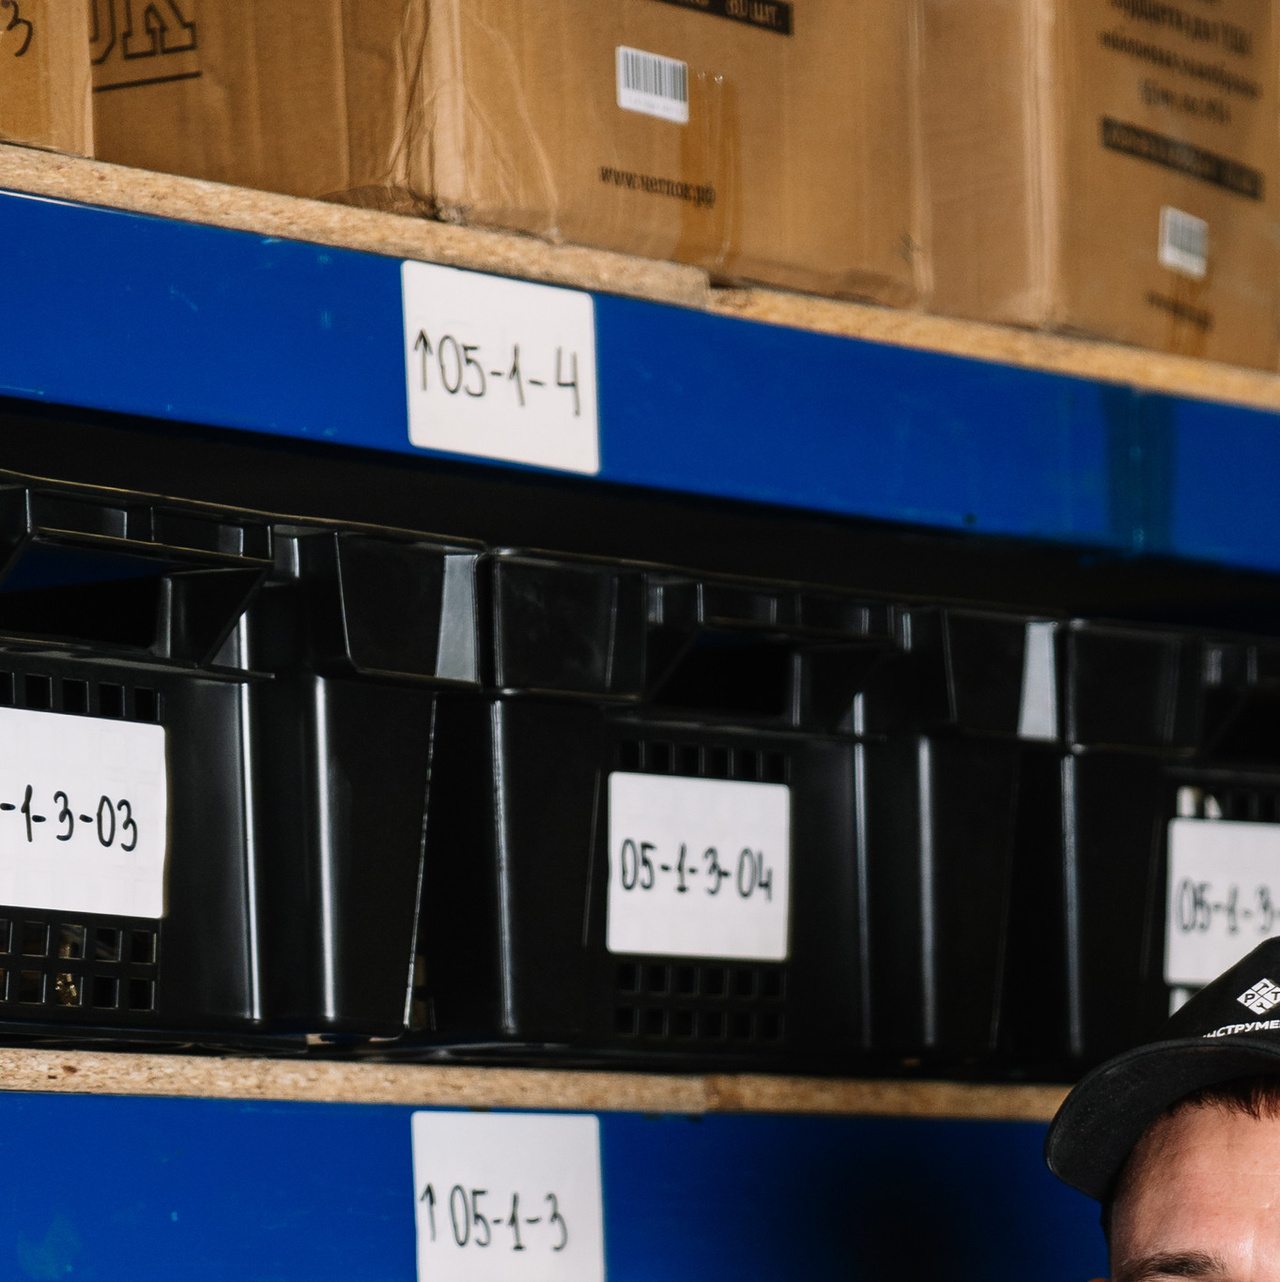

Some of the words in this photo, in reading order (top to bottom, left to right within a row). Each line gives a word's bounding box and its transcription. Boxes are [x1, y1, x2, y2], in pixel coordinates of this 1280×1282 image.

[440, 334, 579, 416] 05-1-4
[620, 838, 773, 901] 05-1-3-04
[450, 1185, 568, 1252] 05-1-3
